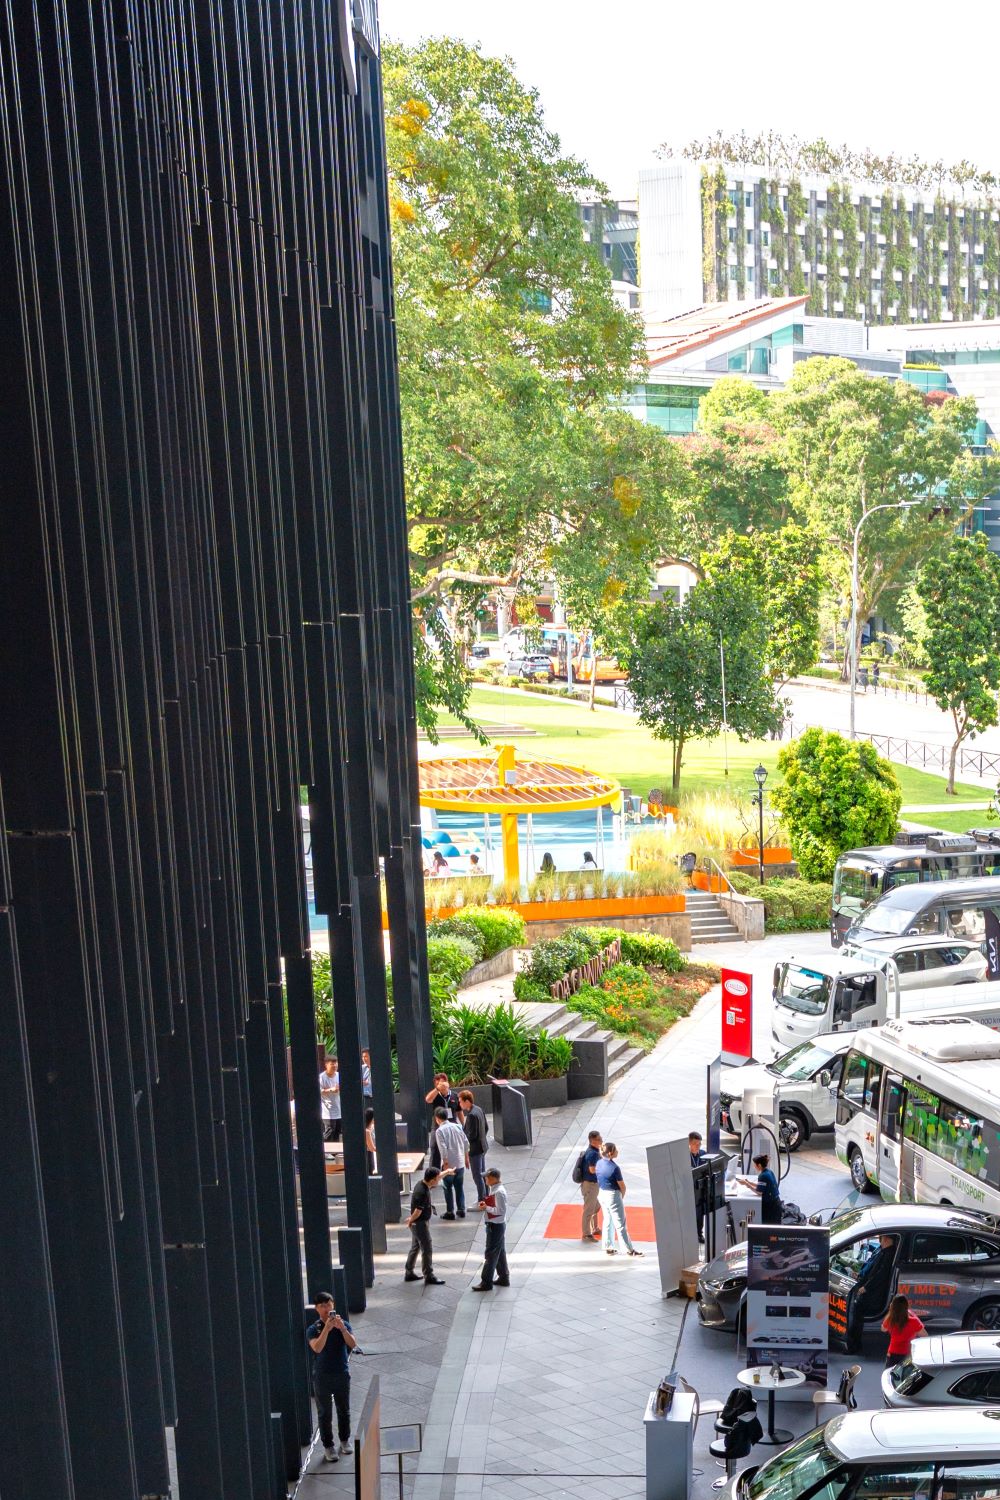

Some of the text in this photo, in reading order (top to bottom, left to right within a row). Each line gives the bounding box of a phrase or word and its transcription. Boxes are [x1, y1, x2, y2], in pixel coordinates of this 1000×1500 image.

[988, 938, 997, 973] KIA
[951, 1174, 986, 1203] TRANSPORT
[829, 1293, 847, 1313] LL-NE
[914, 1284, 935, 1295] IM6
[940, 1284, 957, 1295] EV
